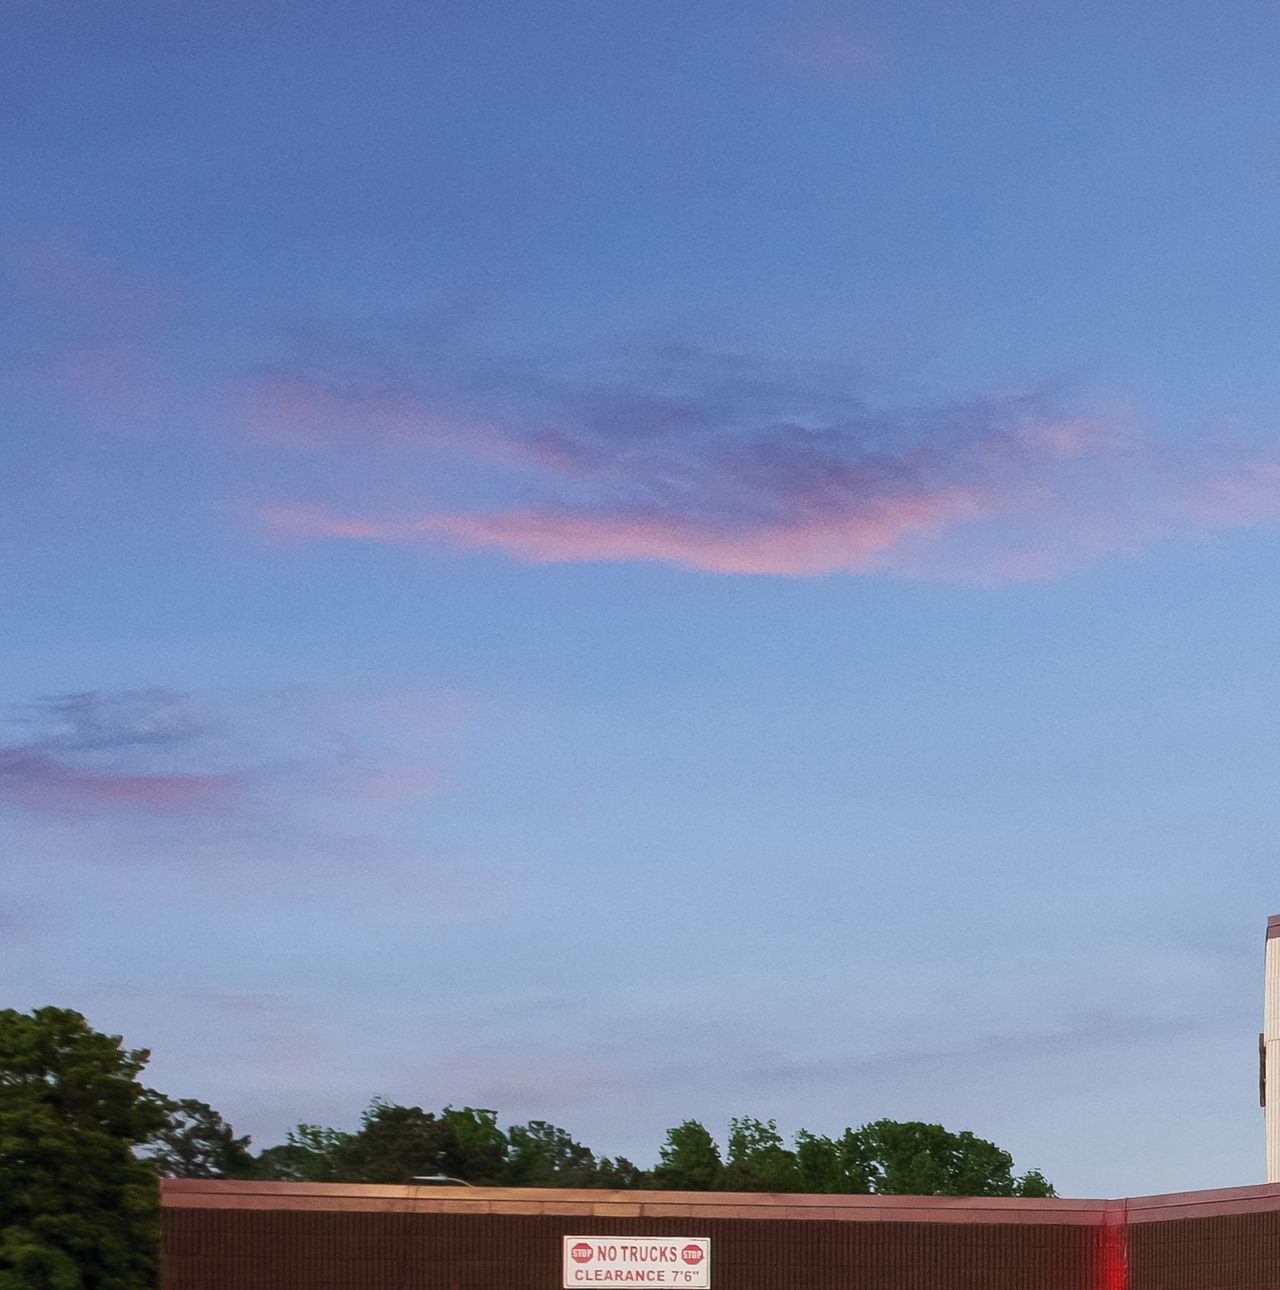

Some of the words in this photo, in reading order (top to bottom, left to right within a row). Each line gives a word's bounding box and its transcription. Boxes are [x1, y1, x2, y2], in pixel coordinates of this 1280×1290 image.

[572, 1249, 592, 1258] STOP
[598, 1245, 617, 1261] NO
[621, 1246, 677, 1262] TRUCKS
[682, 1251, 702, 1260] STOP
[575, 1269, 665, 1281] CLEARANCE
